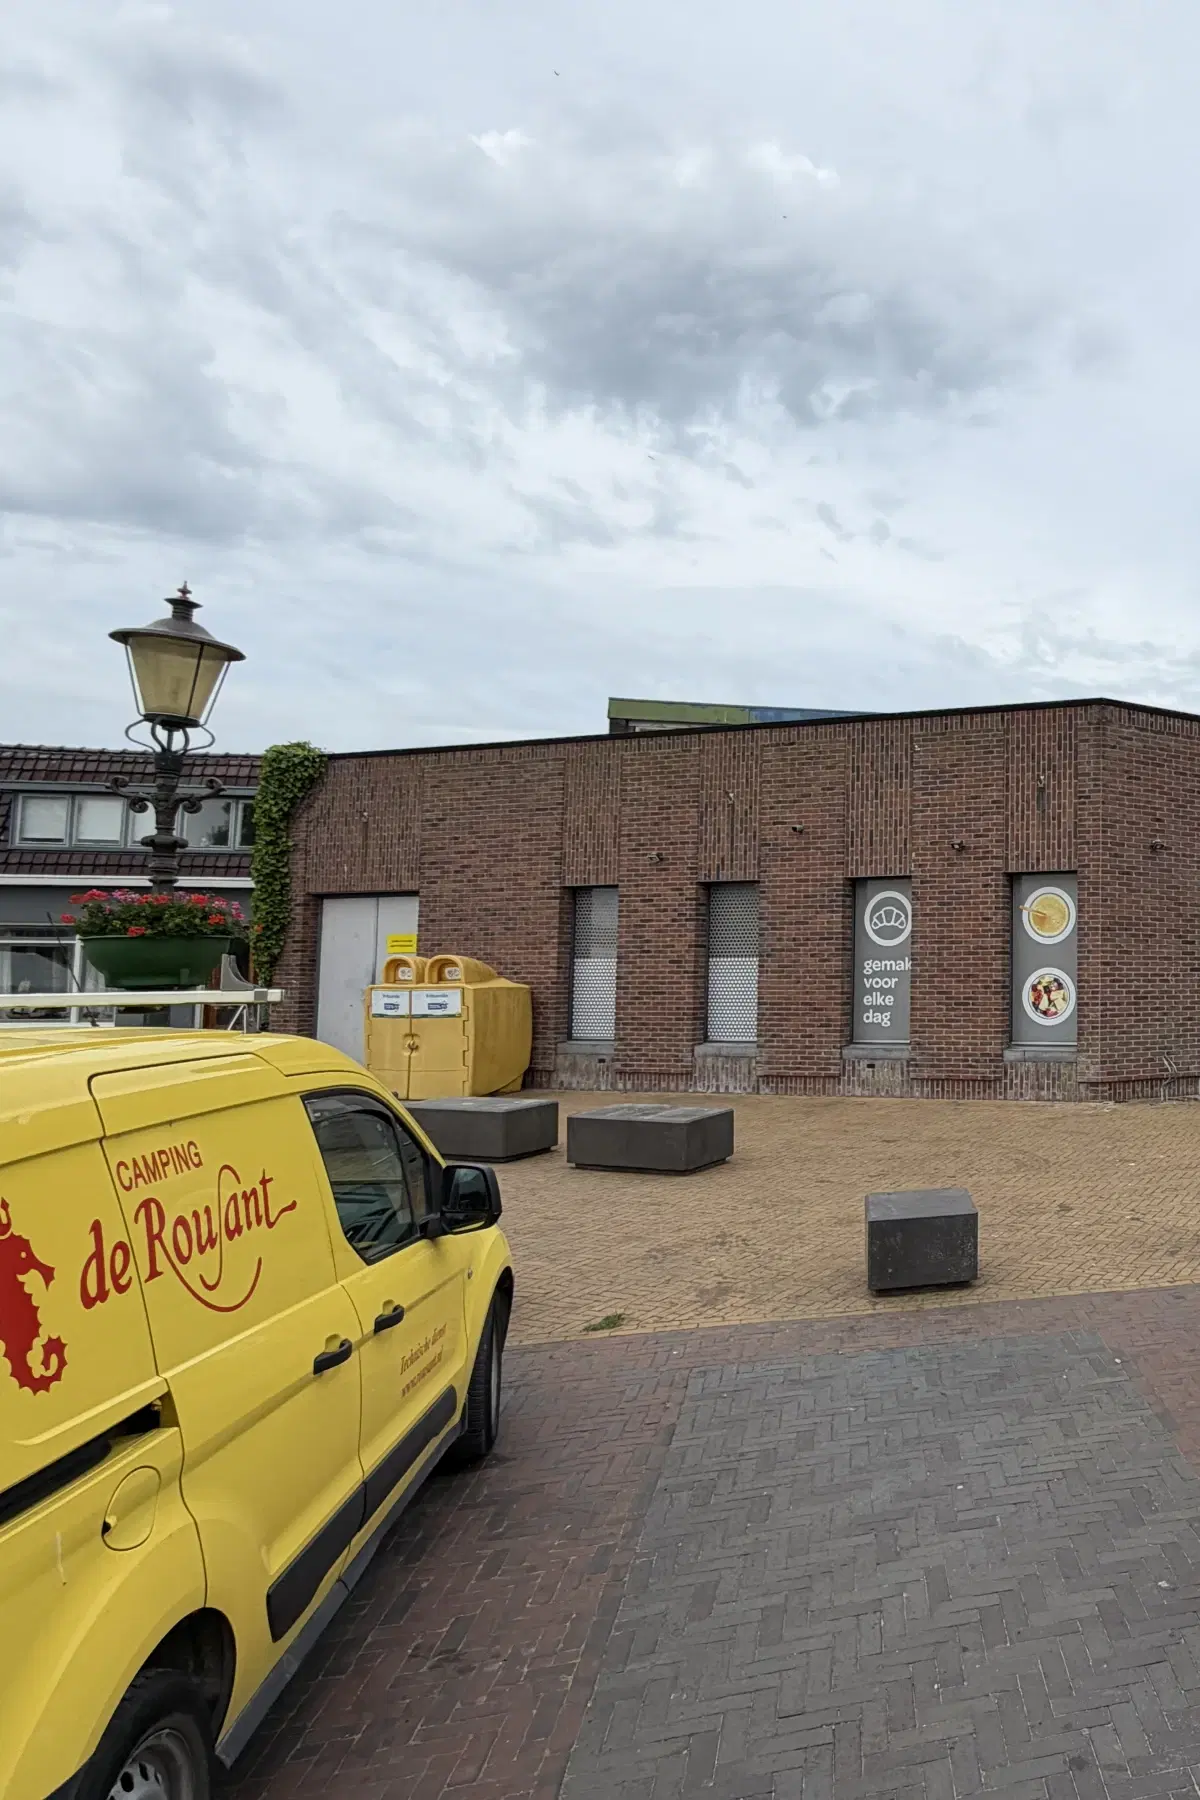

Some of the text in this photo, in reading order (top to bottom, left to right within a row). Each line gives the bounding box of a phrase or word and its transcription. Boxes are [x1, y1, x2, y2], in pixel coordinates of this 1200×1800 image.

[863, 957, 911, 975] gemak
[863, 977, 899, 989] voor
[863, 991, 895, 1006] elke
[863, 1009, 891, 1027] dag
[116, 1140, 203, 1192] CAMPING
[80, 1218, 133, 1310] de
